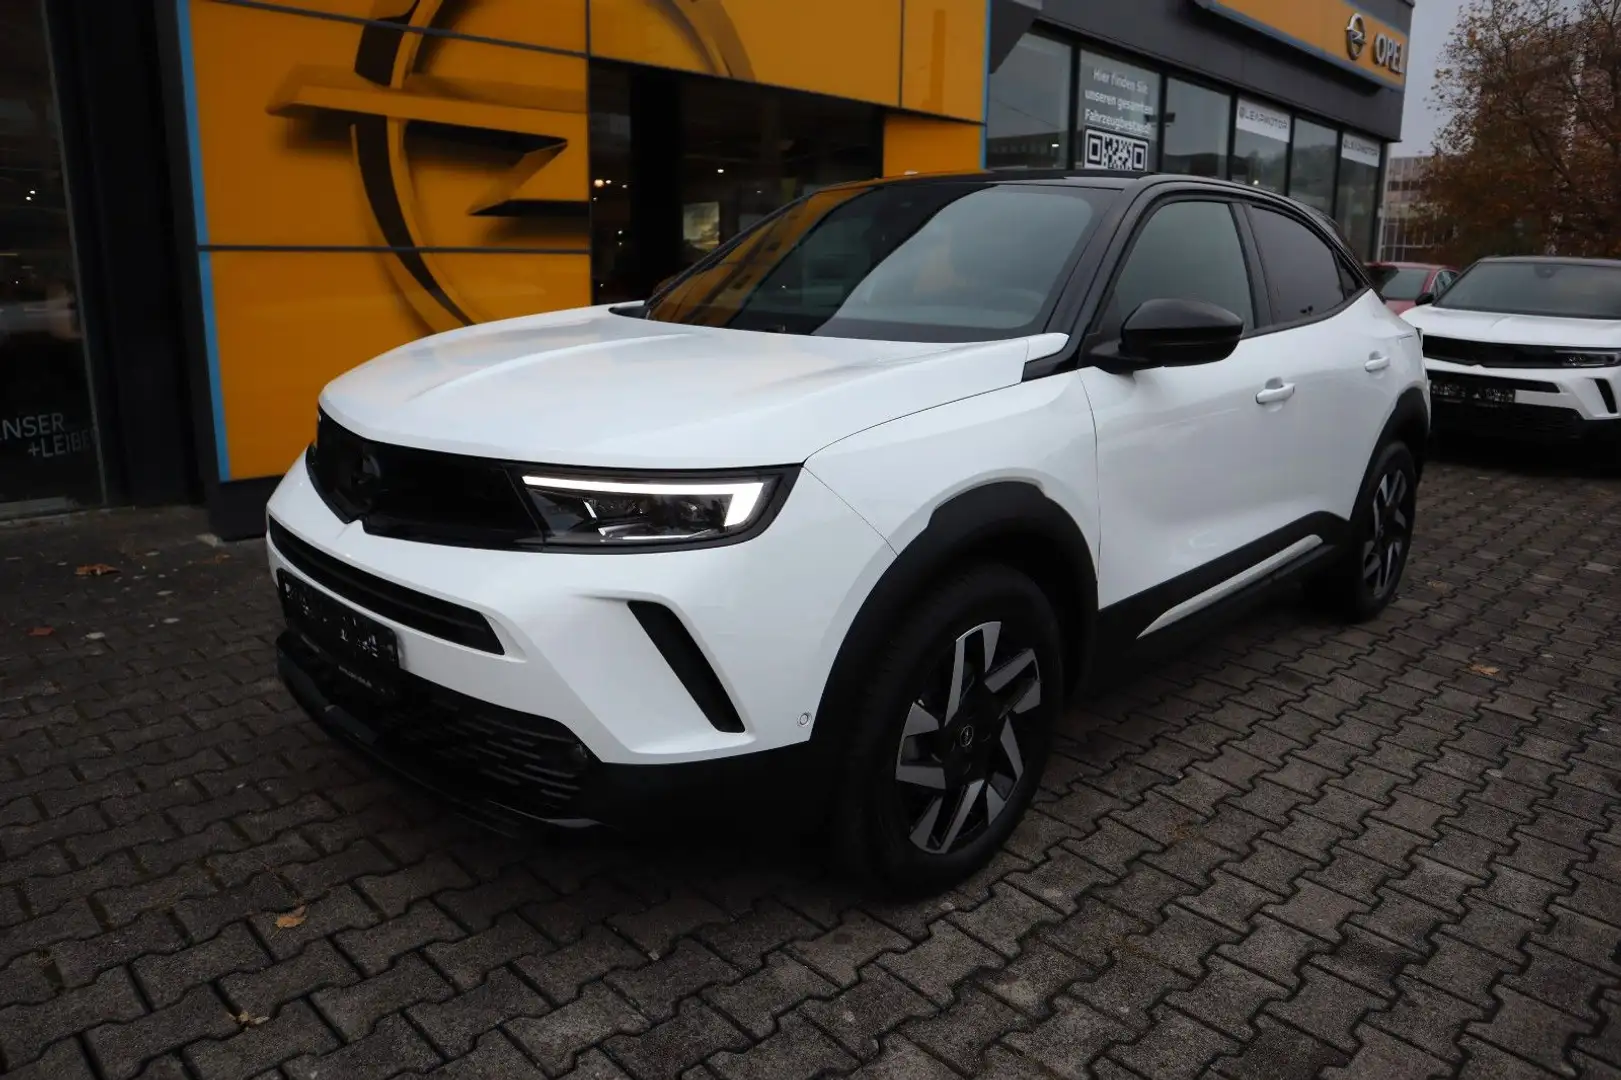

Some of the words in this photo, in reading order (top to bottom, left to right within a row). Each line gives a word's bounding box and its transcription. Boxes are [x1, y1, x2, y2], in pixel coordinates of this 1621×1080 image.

[1374, 33, 1405, 74] OPEL
[1093, 68, 1110, 84] Hier
[1111, 72, 1135, 92] finden
[1137, 81, 1149, 94] Sie
[1085, 89, 1116, 106] unseren
[1117, 97, 1154, 115] gesamten
[0, 412, 65, 441] NSER
